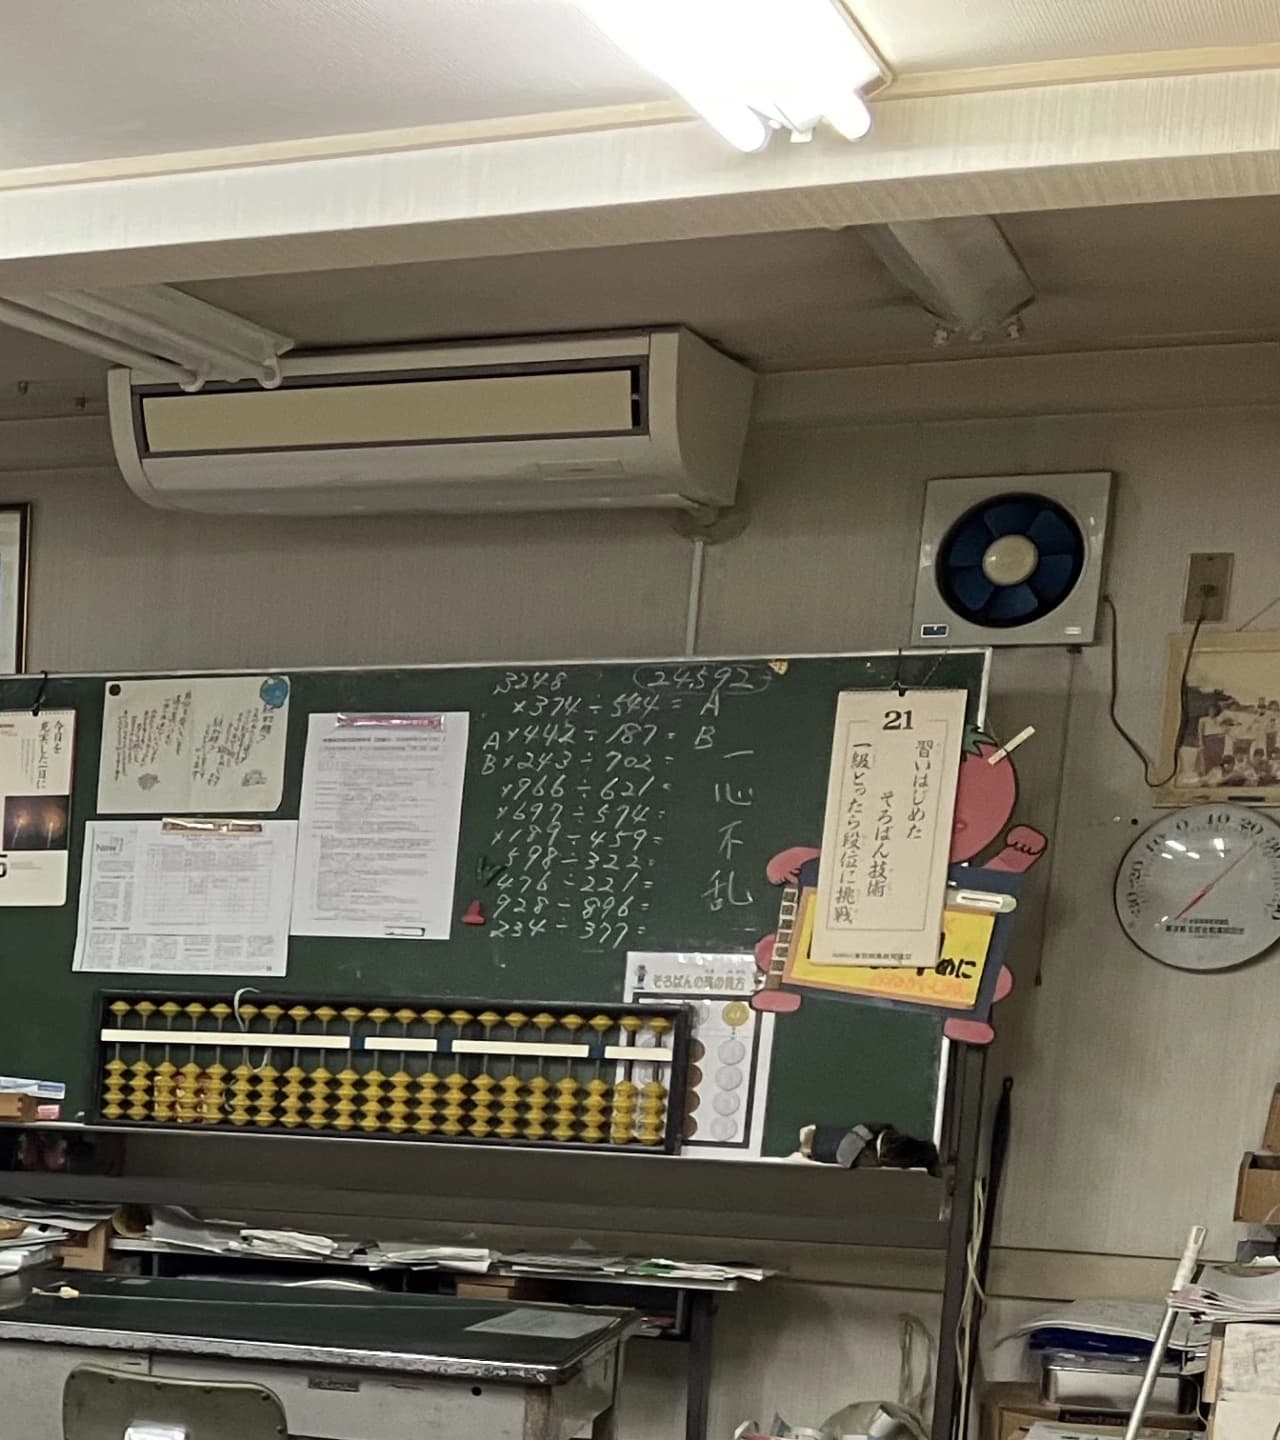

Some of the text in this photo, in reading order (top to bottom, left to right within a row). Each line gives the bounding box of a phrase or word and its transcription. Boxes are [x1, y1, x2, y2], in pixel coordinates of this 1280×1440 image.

[694, 725, 715, 749] B
[700, 690, 720, 717] A
[882, 710, 914, 731] 21
[701, 750, 755, 911] 一心不乱
[833, 741, 872, 924] 一級とったら段位に挑戦
[906, 739, 934, 840] 習いはじめた
[866, 791, 894, 897] そろばん技術
